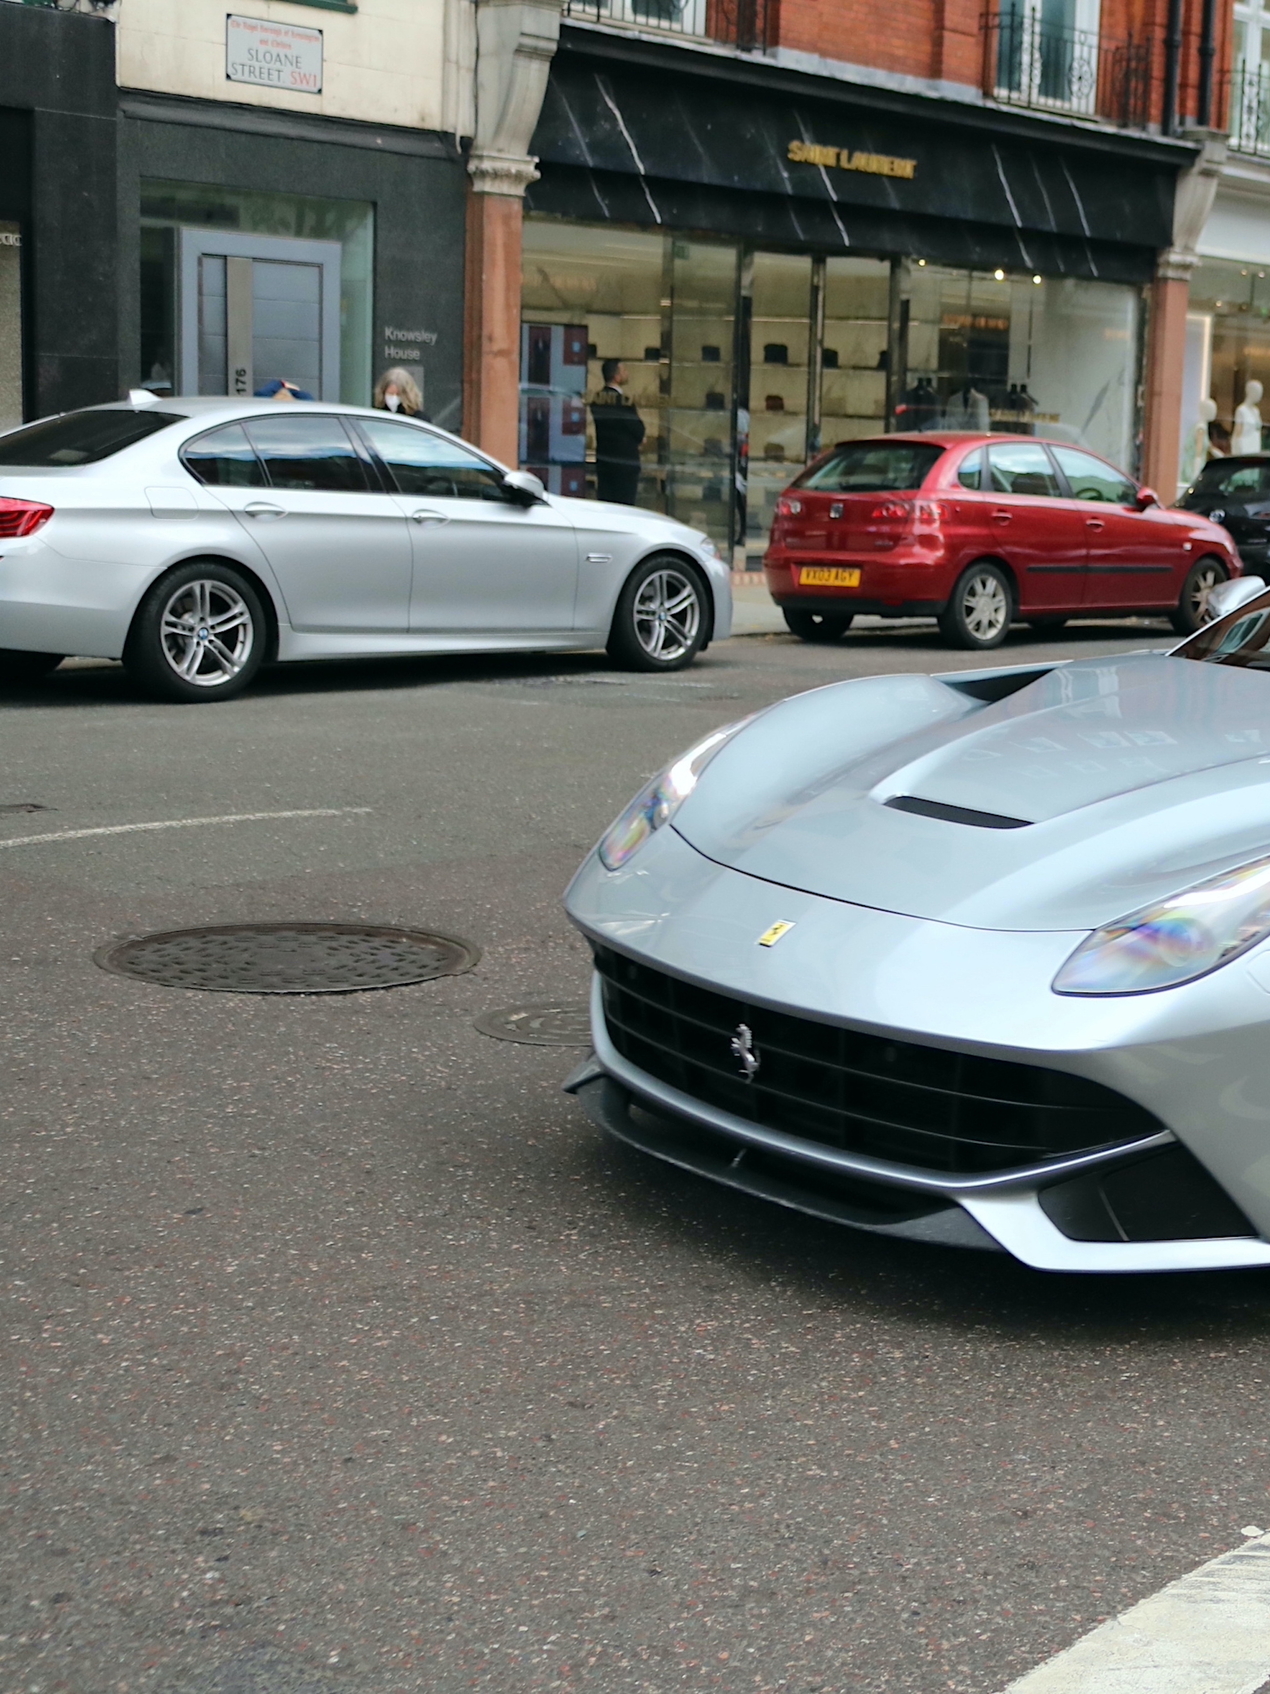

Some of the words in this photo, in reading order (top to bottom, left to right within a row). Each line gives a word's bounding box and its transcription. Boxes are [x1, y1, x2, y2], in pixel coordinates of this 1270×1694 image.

[247, 48, 302, 70] SLOANE
[290, 70, 317, 88] SW1
[787, 140, 841, 168] SAINT
[839, 148, 917, 179] LAURENT
[384, 326, 437, 346] Knowsley
[384, 345, 420, 360] House
[235, 368, 246, 394] 176
